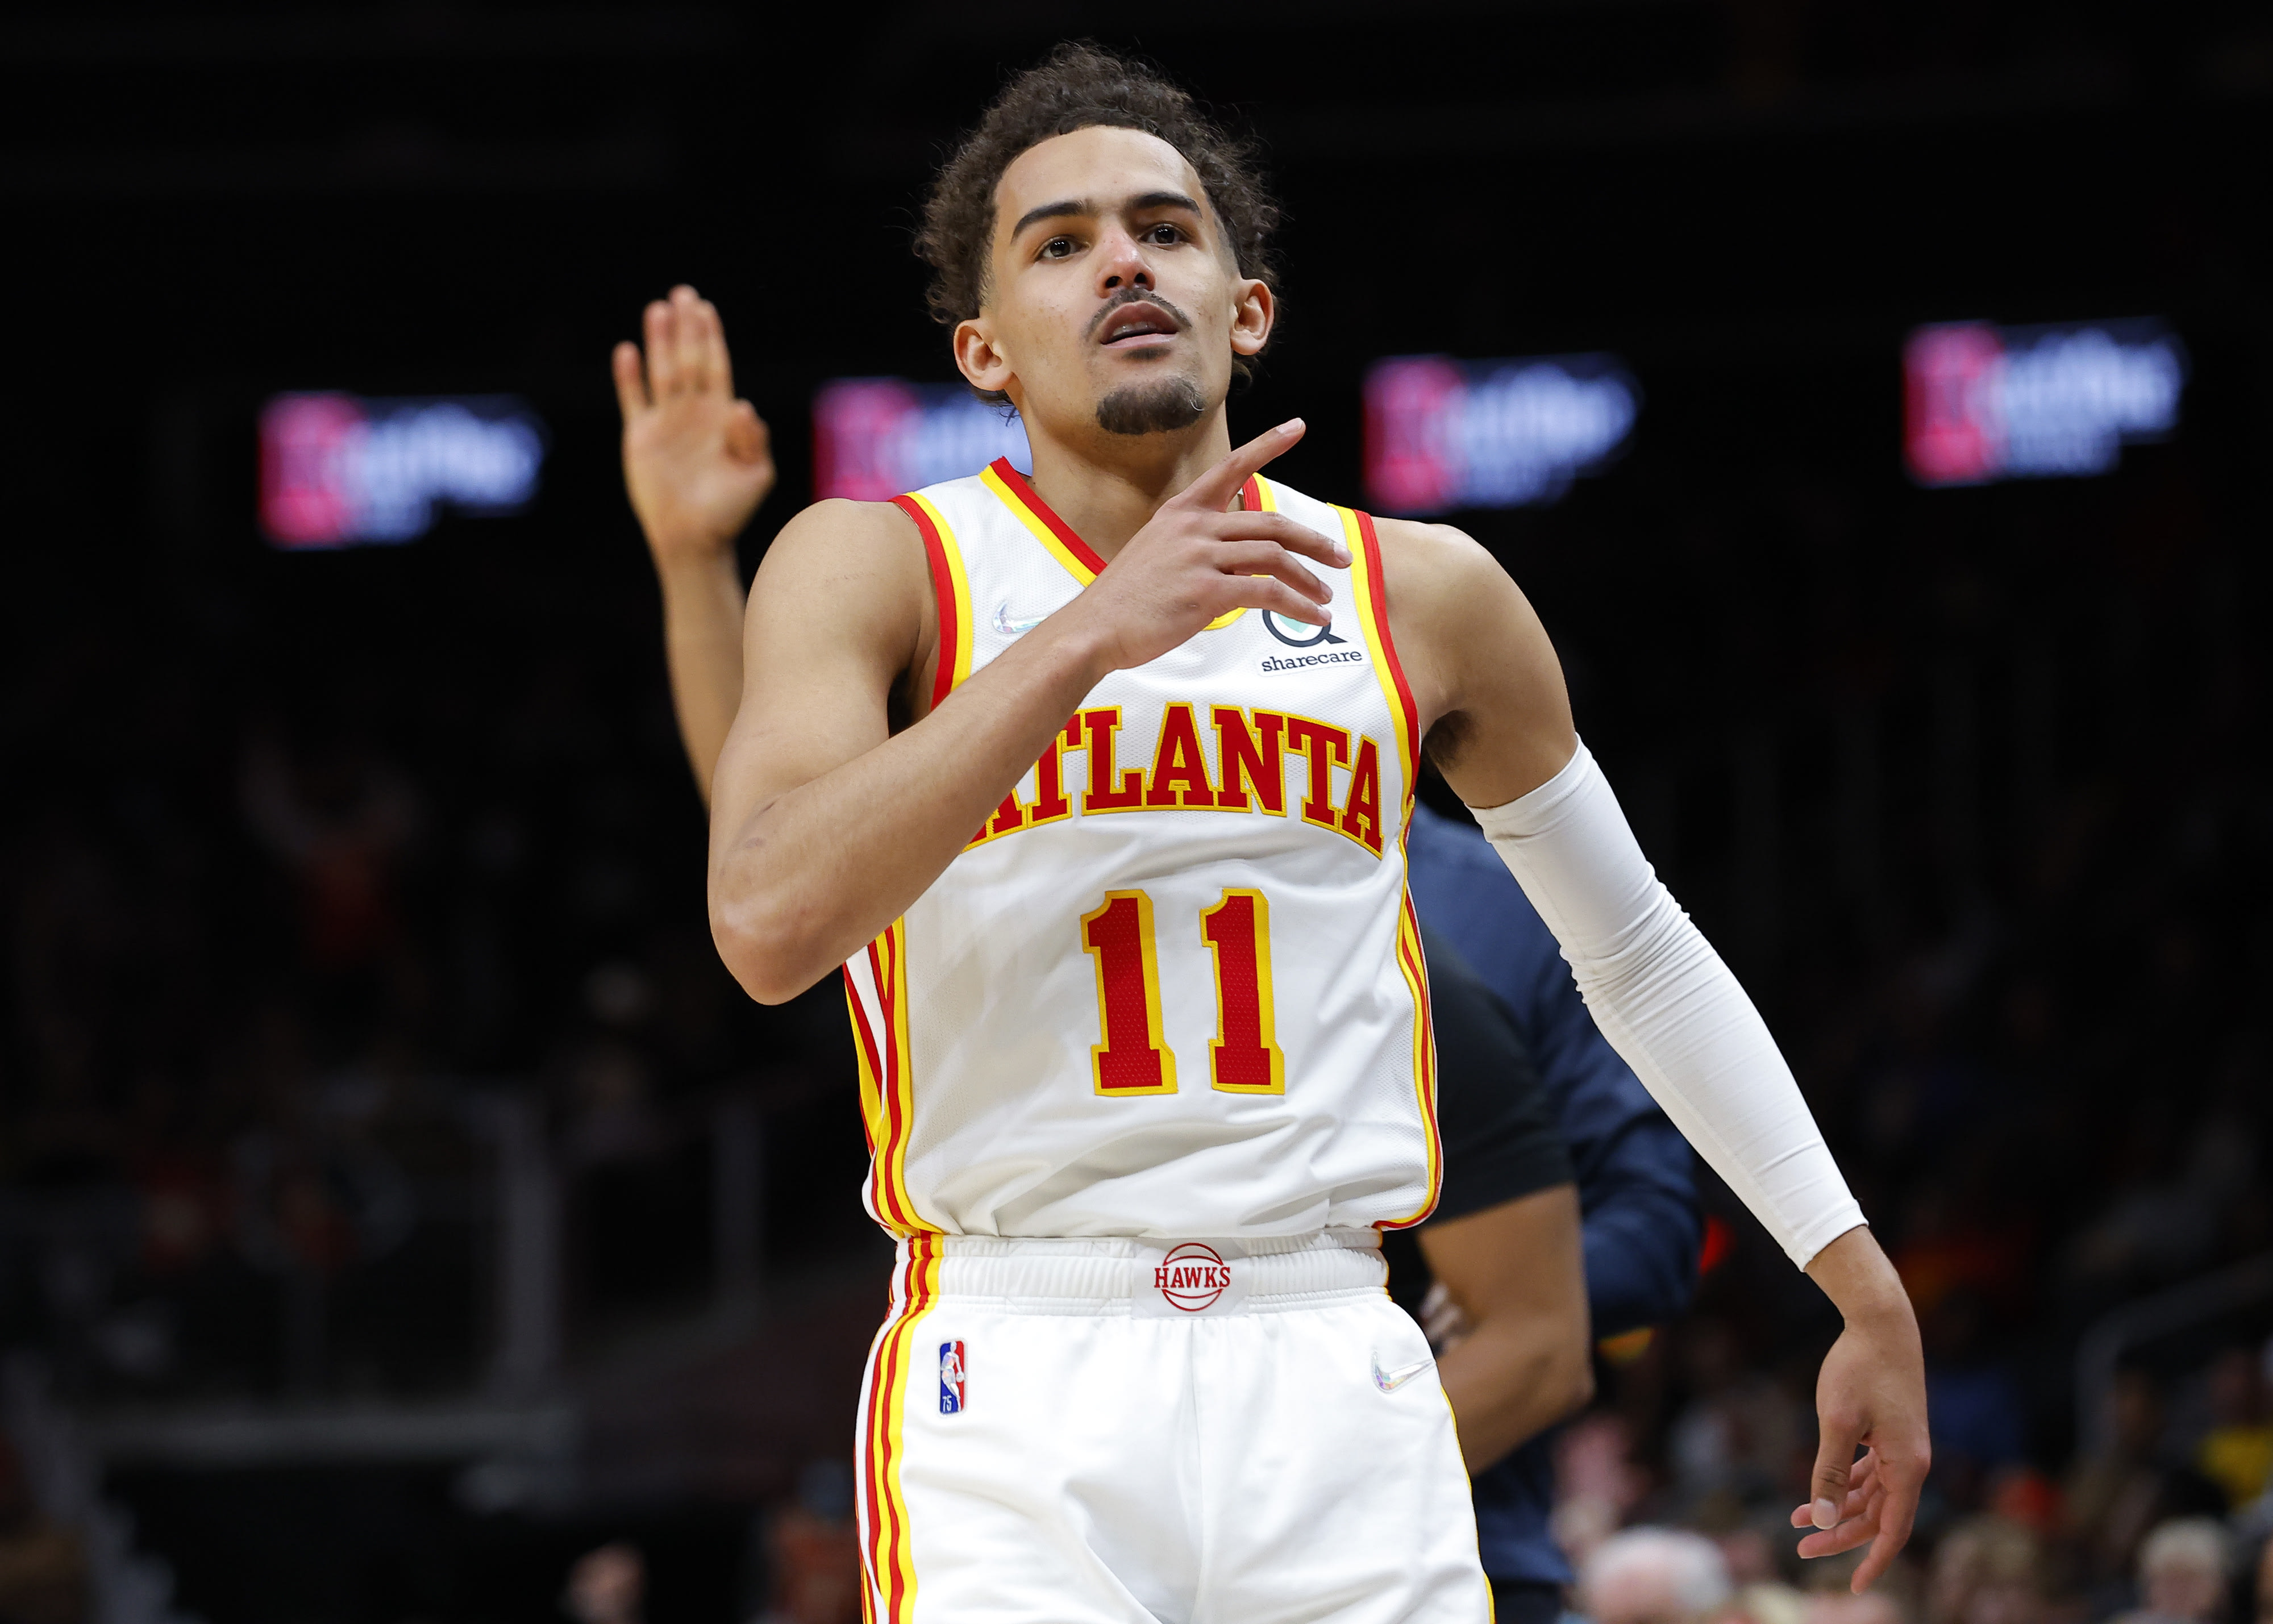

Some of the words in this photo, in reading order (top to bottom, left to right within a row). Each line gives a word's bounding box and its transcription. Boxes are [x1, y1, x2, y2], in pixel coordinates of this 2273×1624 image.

[1262, 651, 1363, 672] sharecare
[1080, 887, 1286, 1097] 11
[1154, 1267, 1231, 1288] HAWKS
